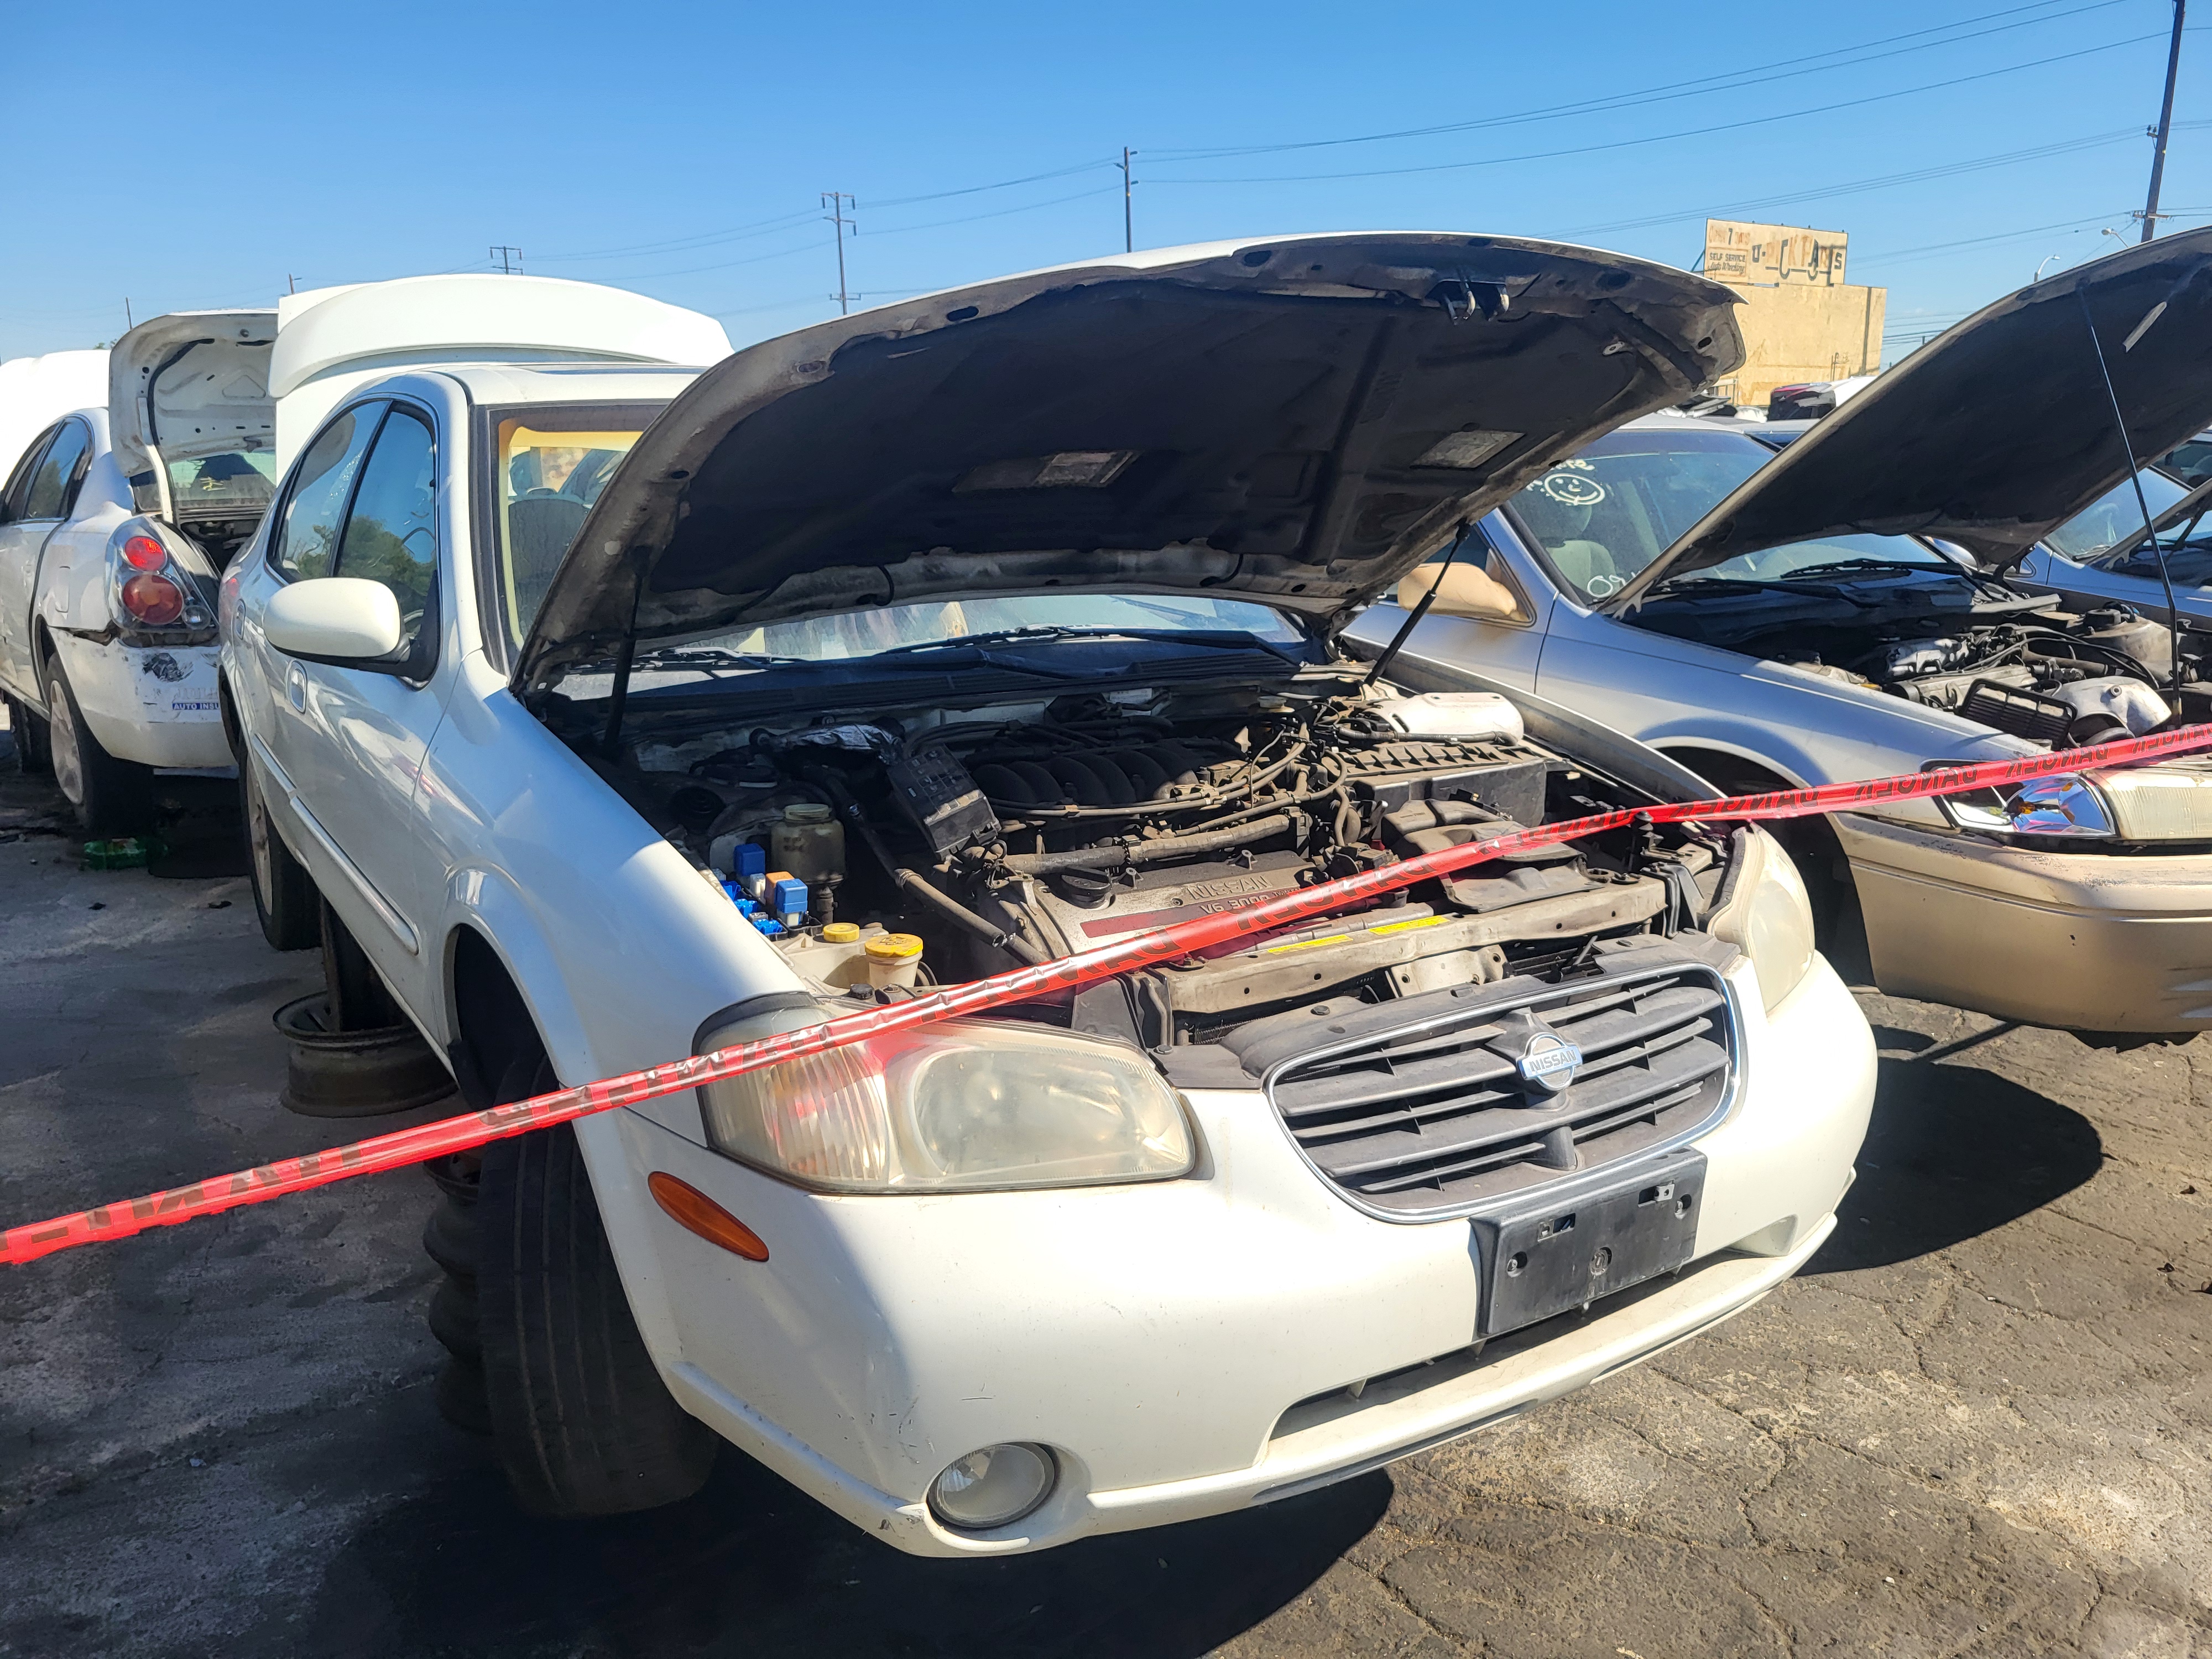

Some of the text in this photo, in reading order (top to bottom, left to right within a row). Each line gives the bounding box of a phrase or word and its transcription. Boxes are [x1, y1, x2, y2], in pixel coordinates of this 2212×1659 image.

[1728, 228, 1733, 246] 7
[1709, 252, 1746, 262] SELF SERVICE
[1187, 875, 1273, 901] NISSAN
[1200, 902, 1224, 915] V6
[1529, 1049, 1576, 1072] NISSAN
